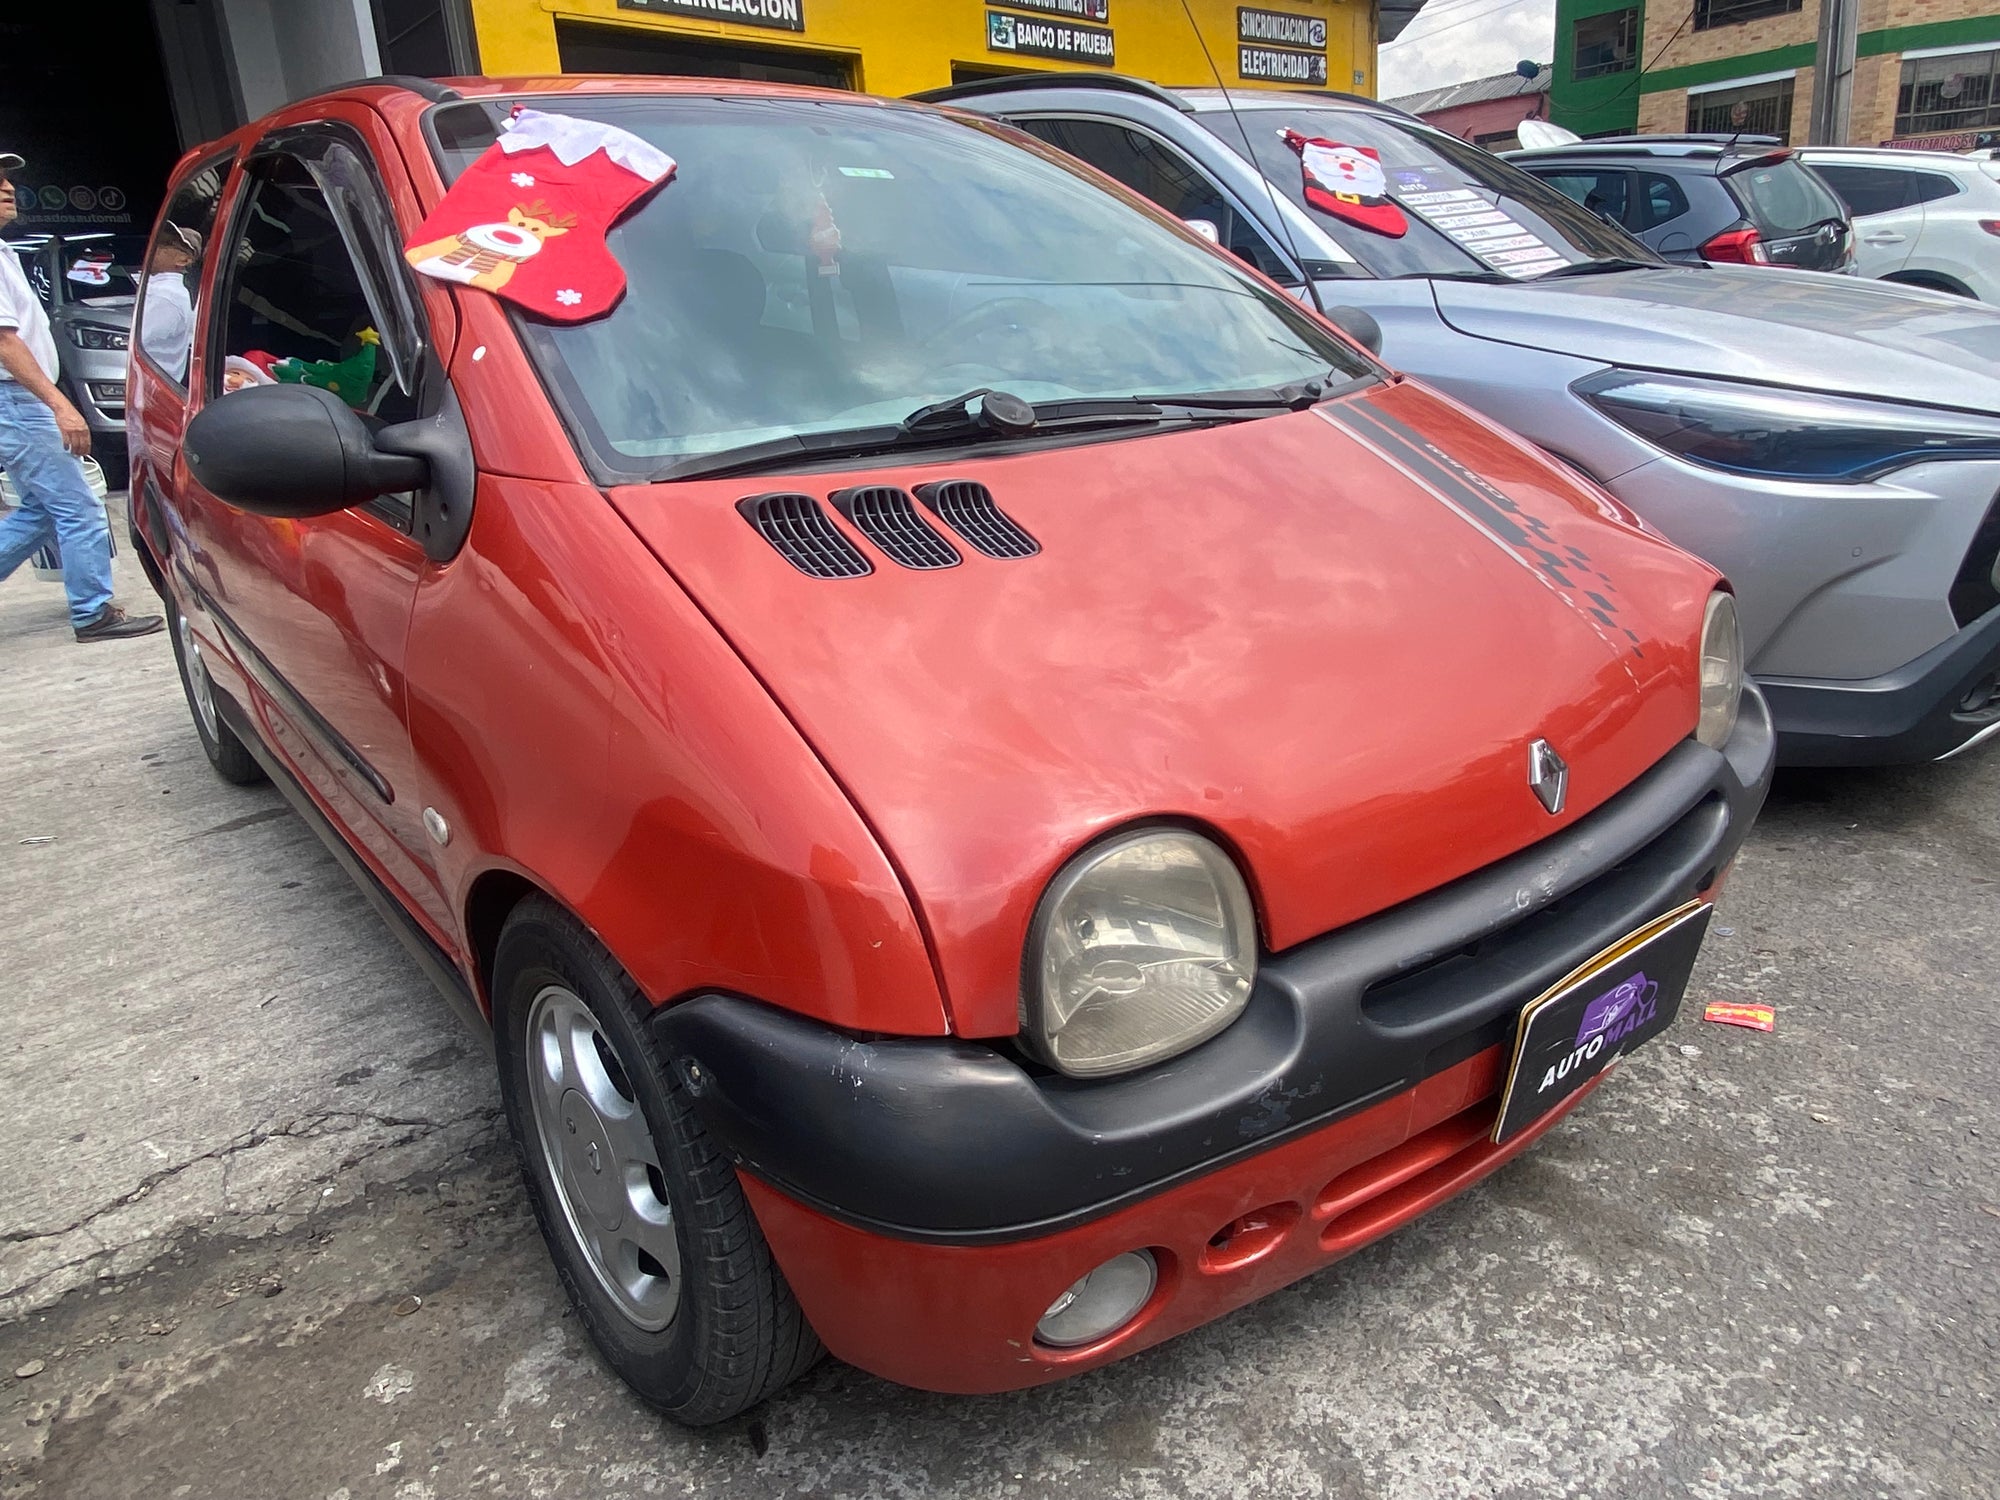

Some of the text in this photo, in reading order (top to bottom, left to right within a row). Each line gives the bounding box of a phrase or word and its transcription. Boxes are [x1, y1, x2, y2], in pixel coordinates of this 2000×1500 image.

[1017, 23, 1114, 56] BANCO DE PRUEBA
[1241, 11, 1308, 43] SINCRONIZACION
[1241, 49, 1310, 79] ELECTRICIDAD
